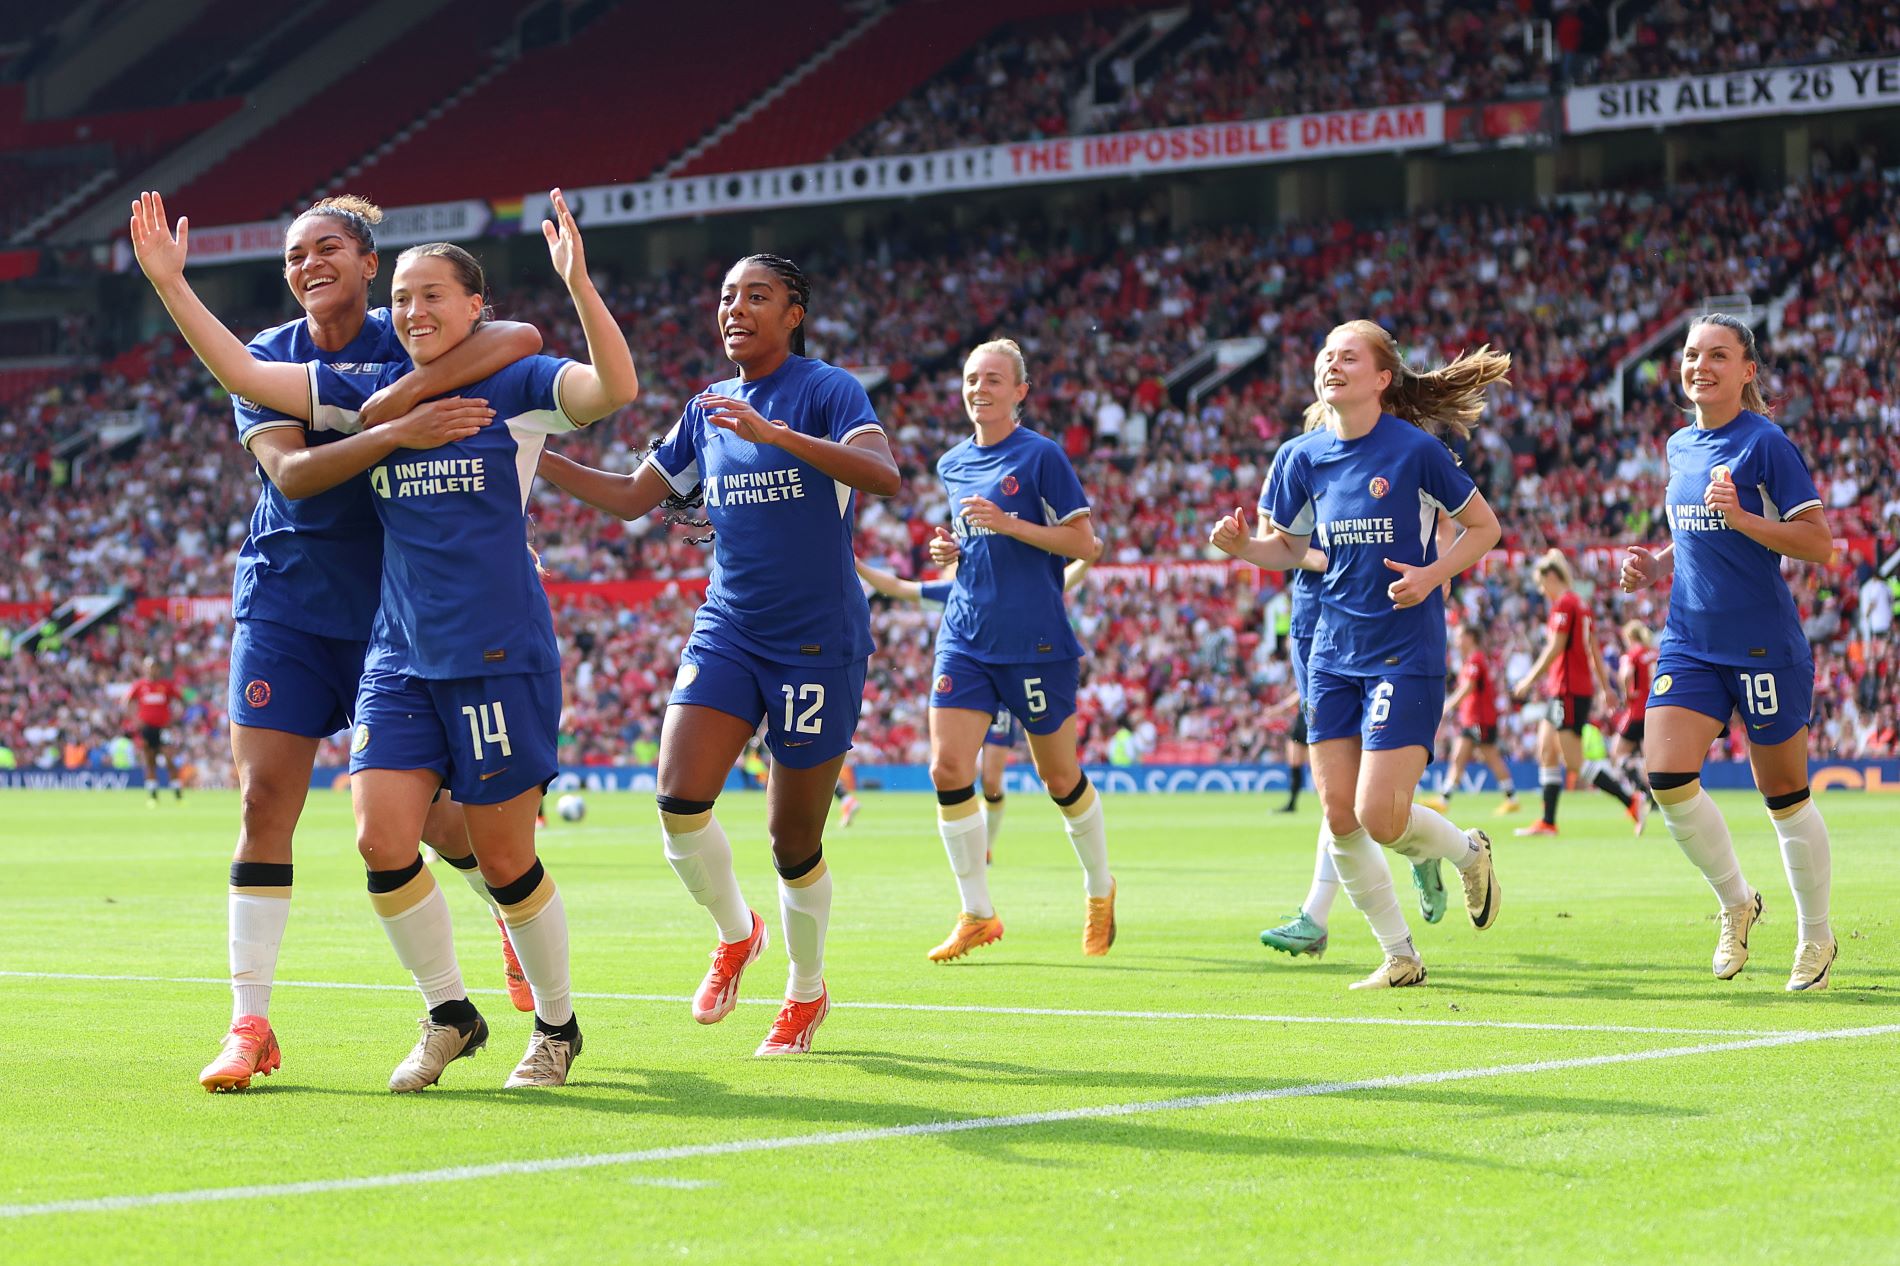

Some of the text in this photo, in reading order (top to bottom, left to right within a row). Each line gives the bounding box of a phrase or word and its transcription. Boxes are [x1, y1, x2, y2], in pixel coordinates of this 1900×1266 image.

[1598, 85, 1661, 118] SIR
[1675, 75, 1775, 111] ALEX
[1788, 66, 1834, 101] 26
[1008, 109, 1427, 176] THE IMPOSSIBLE DREAM
[394, 458, 484, 480] INFINITE
[398, 476, 486, 498] ATHLETE
[723, 467, 801, 489] INFINITE
[725, 483, 805, 506] ATHLETE
[1330, 517, 1394, 533] INFINITE
[1333, 530, 1394, 545] ATHLETE
[781, 683, 825, 734] 12
[1023, 677, 1047, 714] 5
[1370, 681, 1394, 723] 6
[1740, 672, 1779, 716] 19
[462, 701, 512, 761] 14
